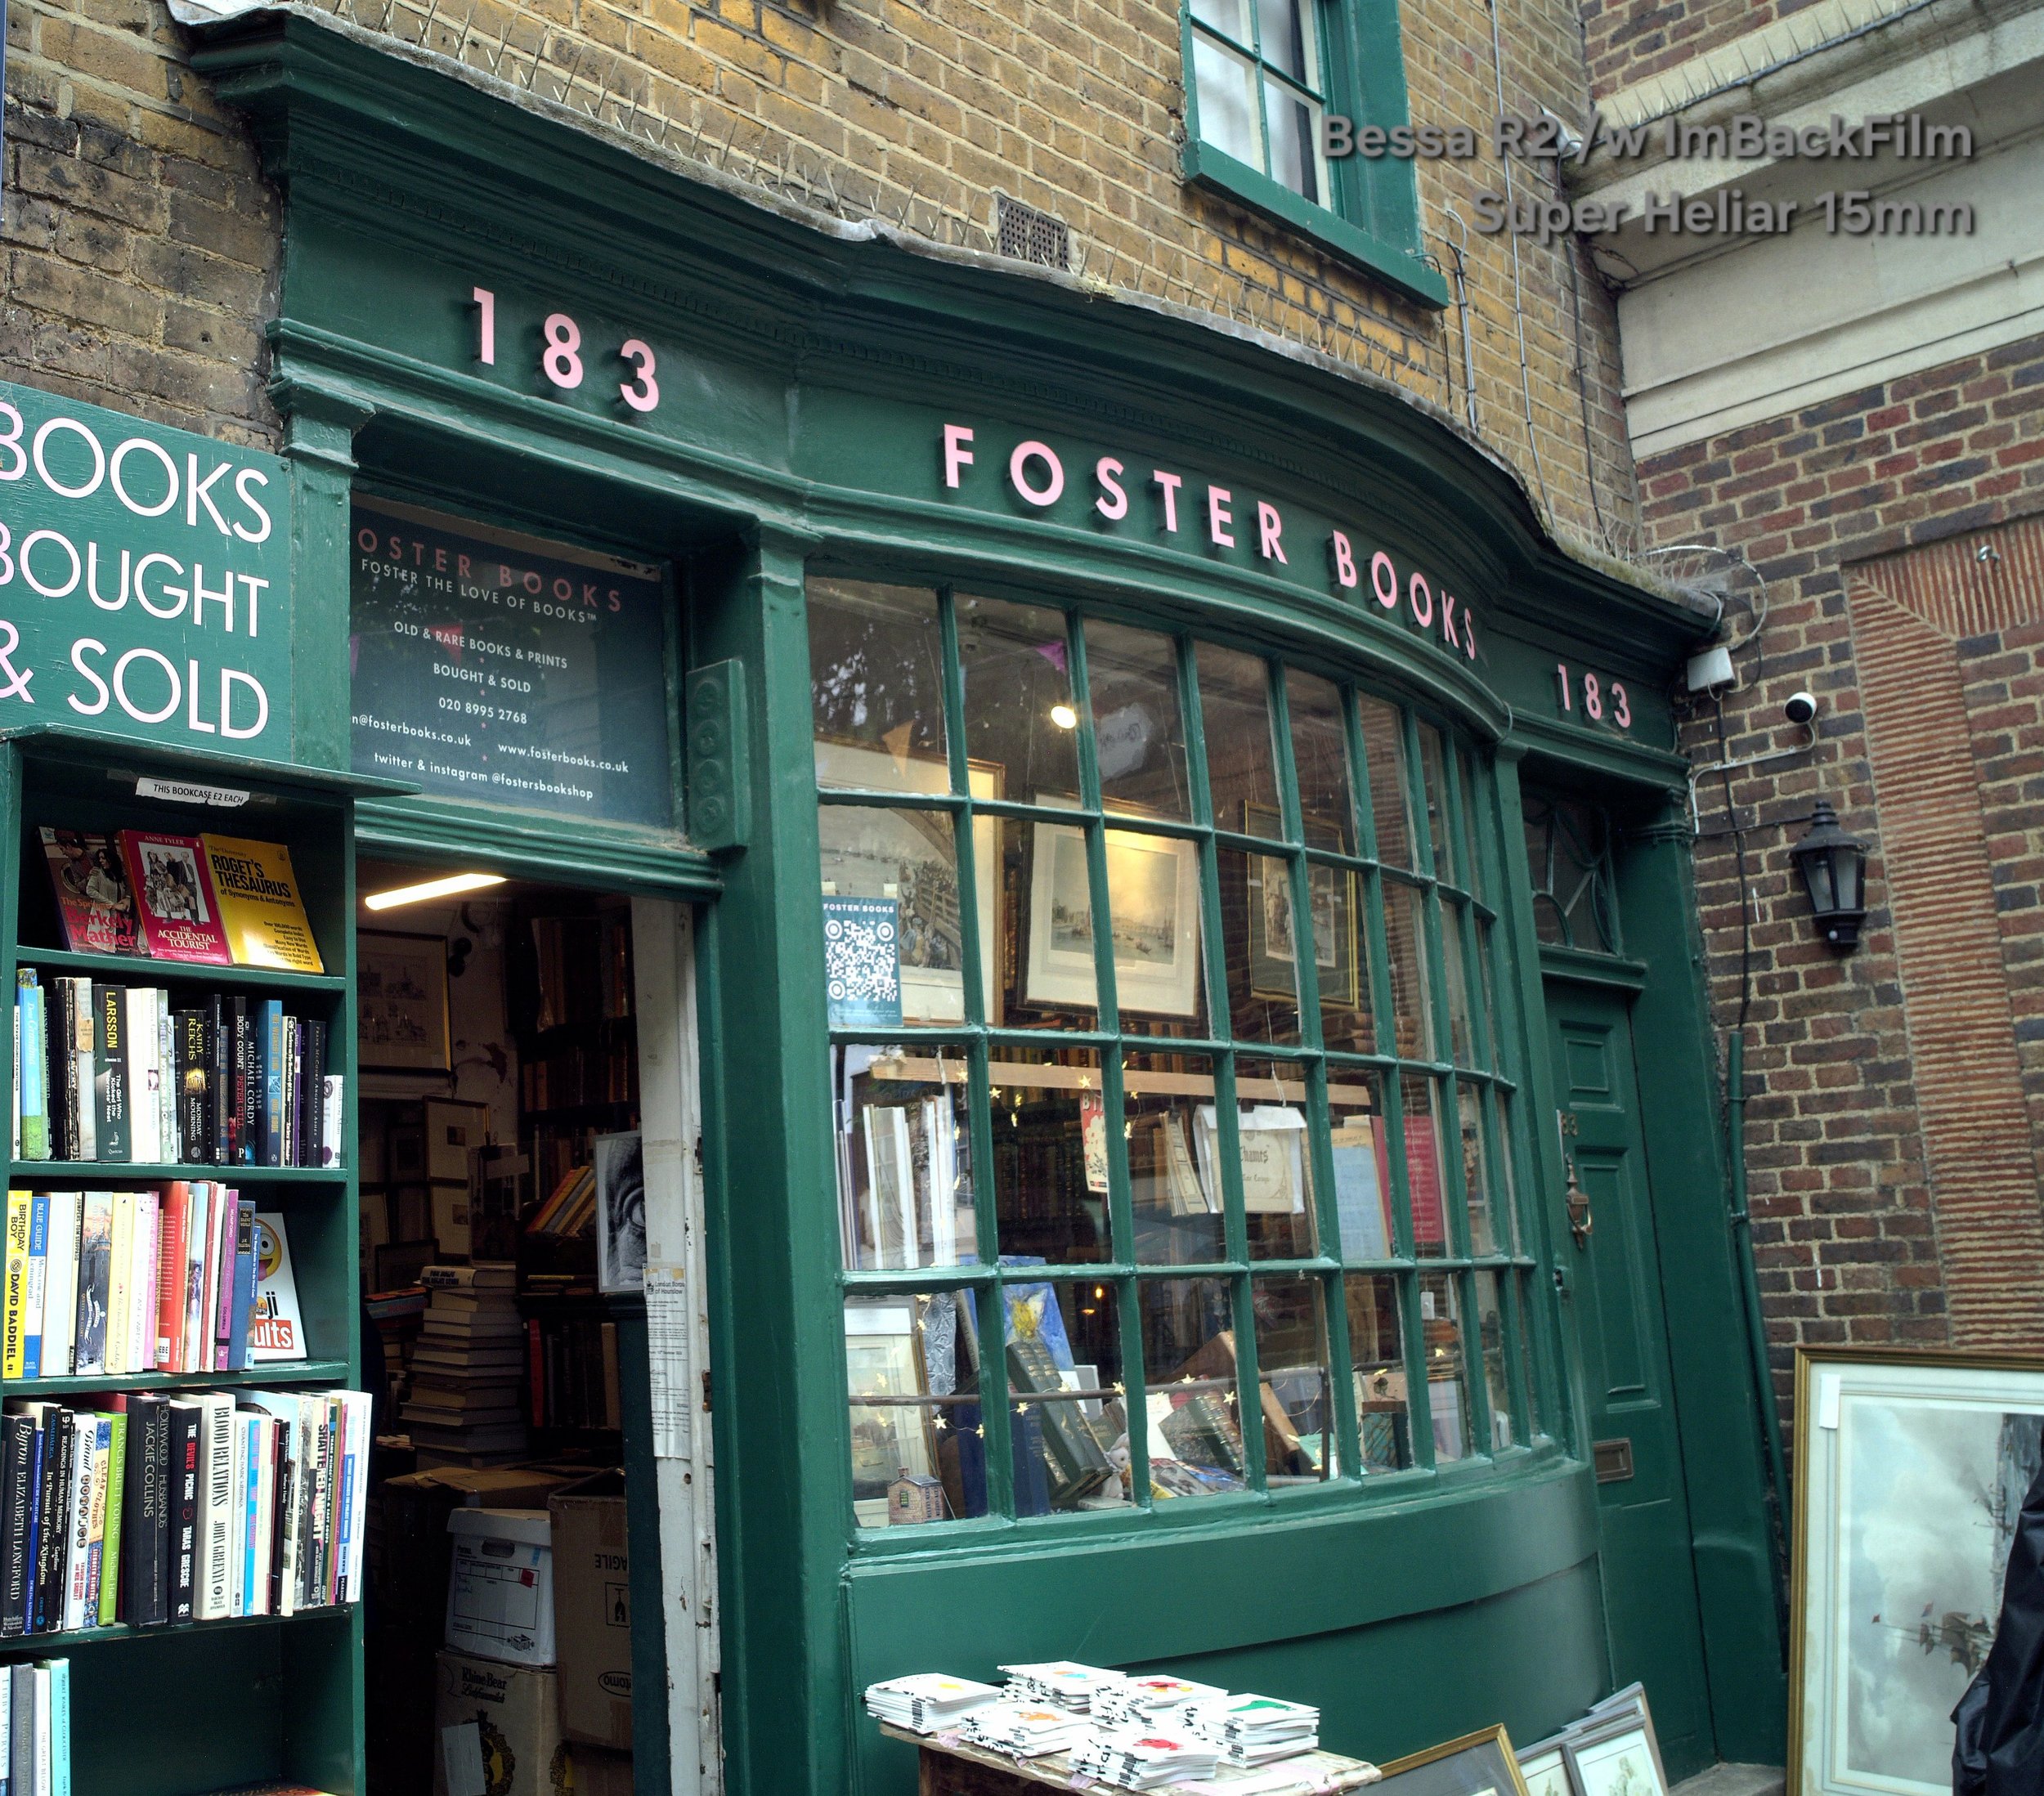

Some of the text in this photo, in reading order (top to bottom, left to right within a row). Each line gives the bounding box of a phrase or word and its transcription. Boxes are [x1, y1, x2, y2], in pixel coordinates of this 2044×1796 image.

[473, 286, 660, 412] 183
[0, 401, 272, 544] BOOKS
[943, 423, 1477, 661] FOSTER BOOKS
[361, 558, 419, 585] FOSTER
[426, 576, 454, 593] THE
[460, 584, 500, 605] LOVE
[506, 596, 527, 610] OF
[499, 564, 622, 613] BOOKS
[393, 621, 568, 670] OLD & RARE BOOKS & PRINTS
[0, 619, 269, 740] & SOLD
[433, 663, 531, 693] BOUGHT & SOLD
[1558, 663, 1631, 728] 183
[438, 697, 528, 725] 020 8995 2768
[374, 751, 594, 801] twitter & instagram @fostersbookshop
[498, 741, 630, 773] www.fosterbooks.co.uk
[153, 783, 244, 804] THIS BOOKCASE £2 EACH
[144, 835, 185, 846] ANNE TYLER
[210, 853, 265, 879] ROGET'S
[214, 871, 292, 898] THESAURUS
[227, 889, 259, 902] Synonyms
[265, 896, 296, 907] Antonyms
[823, 902, 895, 914] FOSTER BOOKS
[69, 924, 137, 947] Mather
[158, 929, 218, 943] ACCIDENTAL
[168, 938, 211, 951] TOURIST
[105, 992, 118, 1049] LARSSON
[159, 1023, 168, 1056] HELLER
[187, 1017, 197, 1060] REICHS
[195, 1022, 204, 1055] KATHY
[236, 1014, 244, 1130] BODY COUNT PETER GILL
[246, 1041, 255, 1126] MICHAEL CORDY
[10, 1216, 19, 1238] BOY
[17, 1203, 27, 1251] BIRTHDAY
[34, 1203, 44, 1251] BLUE GUIDE
[27, 1258, 37, 1300] Leningrad
[34, 1258, 45, 1309] Moscow and
[7, 1274, 20, 1360] DAVID BADDIEL
[15, 1422, 34, 1466] Byron
[213, 1406, 231, 1444] BLOOD
[82, 1430, 96, 1471] Brand
[143, 1422, 155, 1518] JACKIE COLLINS
[158, 1404, 169, 1529] HOLLYWOOD HUSBANDS
[92, 1459, 107, 1530] CLEAN CLOTHES
[212, 1446, 230, 1507] RELATIONS
[312, 1424, 329, 1544] SHATTERED NIGHT
[13, 1471, 26, 1537] ELIZABETH
[52, 1435, 68, 1571] READINGS IN HUMAN MEMORY Gardiner
[108, 1422, 125, 1600] FRANCIS BRETT YOUNG Michael Hall
[180, 1423, 196, 1588] THE DEVIL'S PICNIC TARAS GRESCOE
[38, 1471, 54, 1586] In Pursuit of the Kingdom
[213, 1520, 226, 1544] JOHN
[10, 1540, 24, 1601] LONGFORD
[212, 1545, 225, 1584] GREENYA
[486, 1673, 508, 1691] Bear
[0, 1679, 10, 1768] LIBBY PURVES
